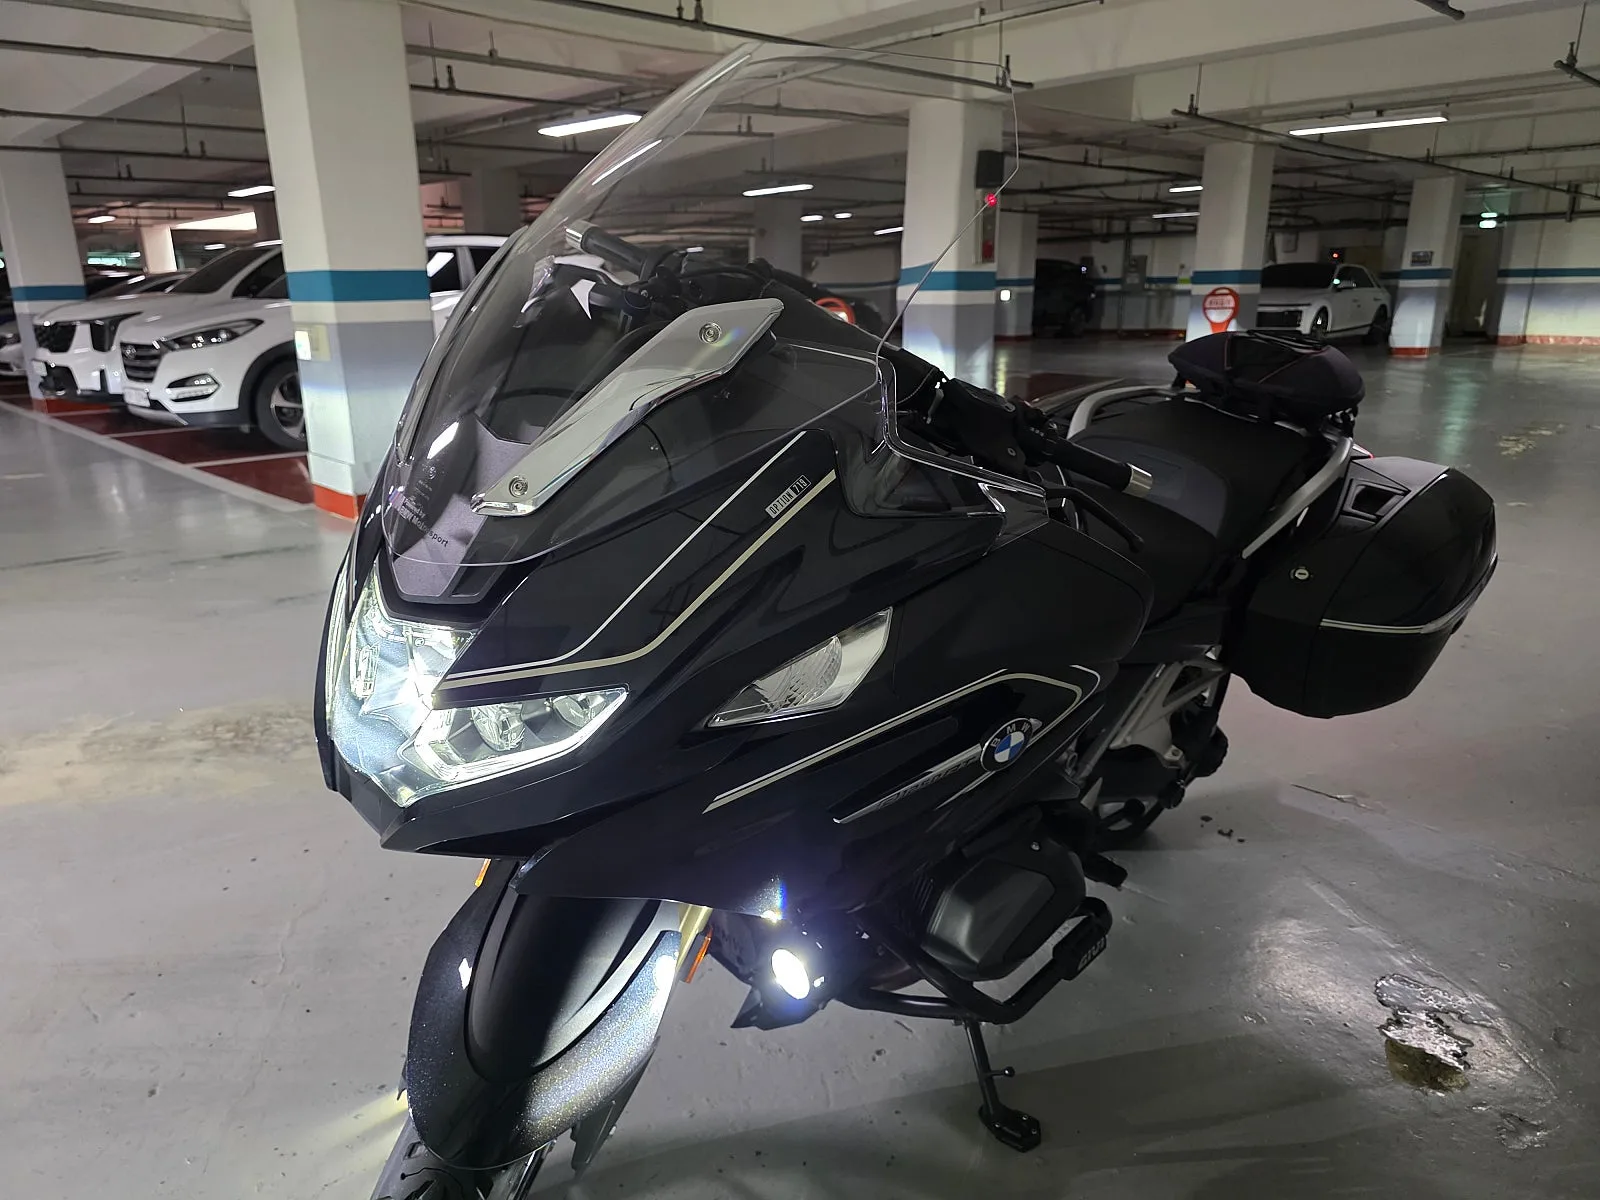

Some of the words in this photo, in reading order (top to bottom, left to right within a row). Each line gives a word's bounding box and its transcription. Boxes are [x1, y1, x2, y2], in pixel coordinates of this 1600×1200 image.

[769, 491, 794, 515] OPTION
[793, 478, 808, 493] 719
[411, 515, 449, 548] Motorsport
[990, 722, 1031, 747] BMW
